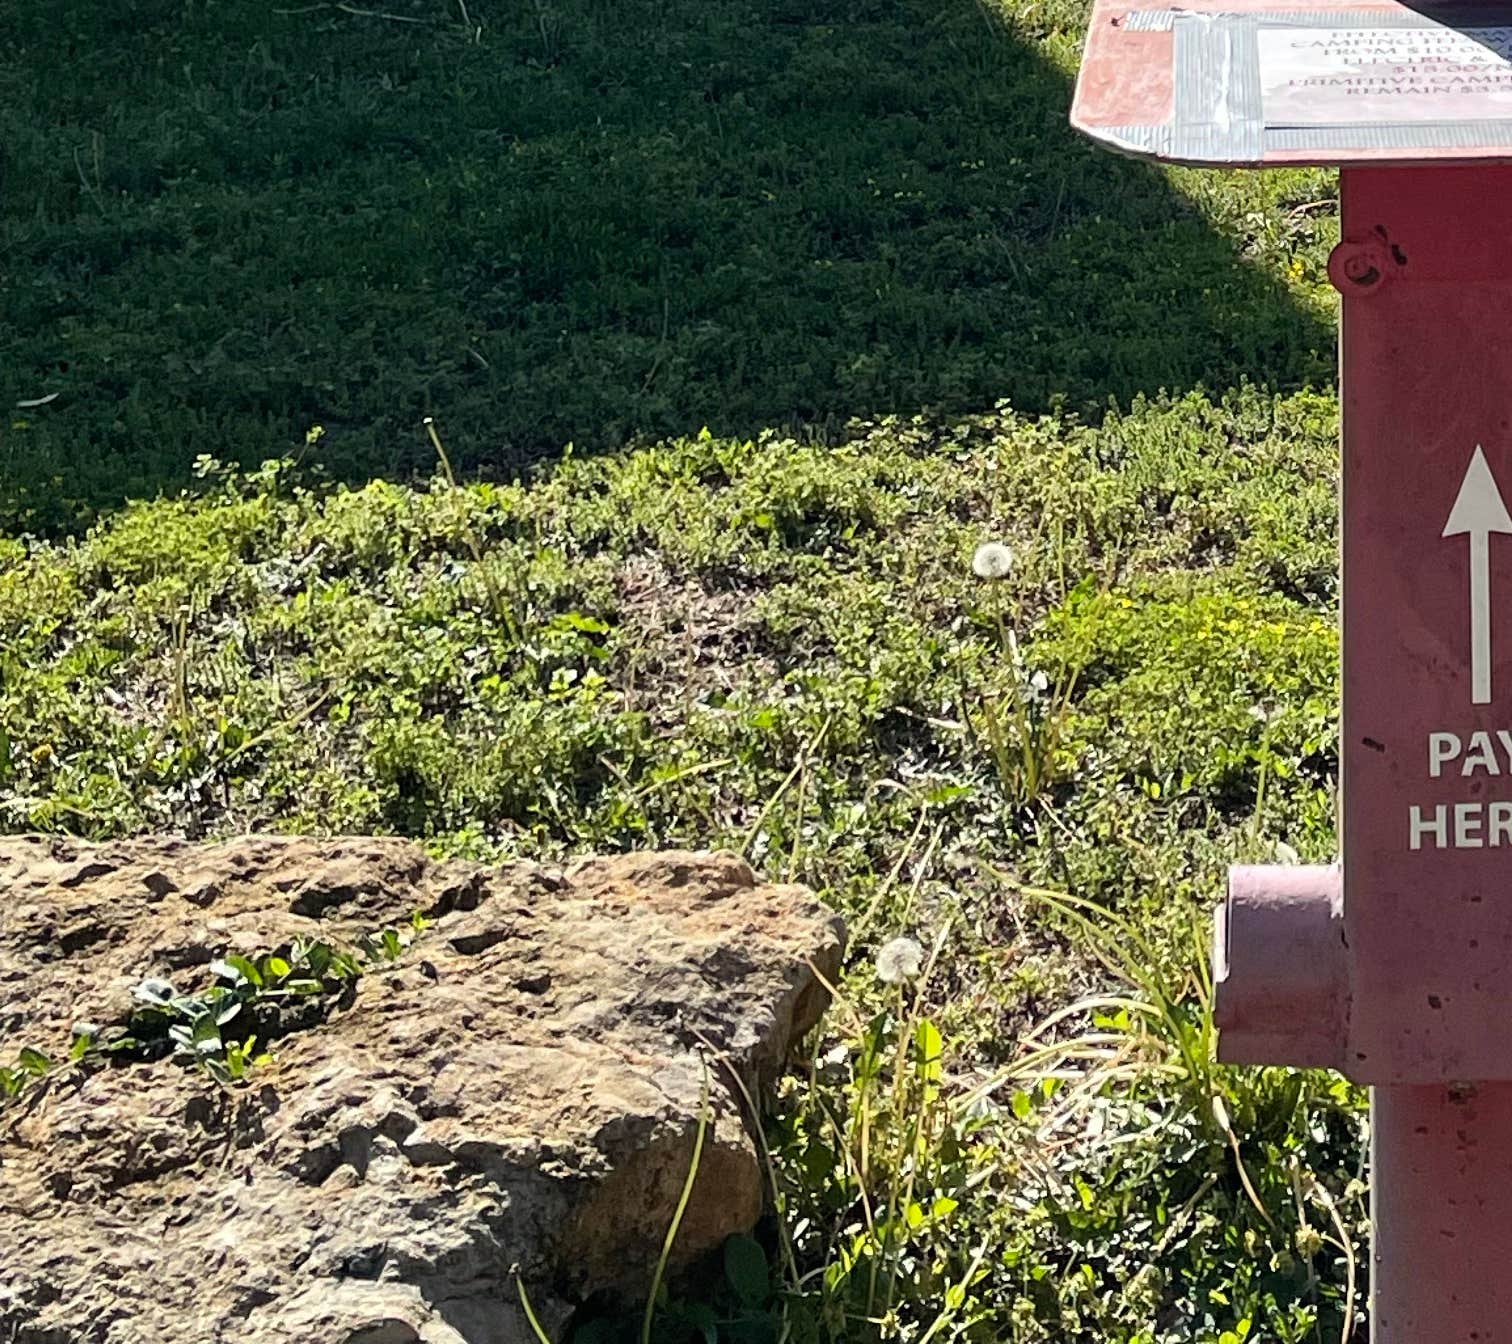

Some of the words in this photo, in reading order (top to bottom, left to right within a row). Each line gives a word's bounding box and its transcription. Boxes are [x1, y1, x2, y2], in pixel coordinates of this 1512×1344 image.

[1290, 38, 1415, 48] CAMPING
[1289, 77, 1425, 86] PRIMITIVE
[1346, 86, 1451, 95] REMAIN
